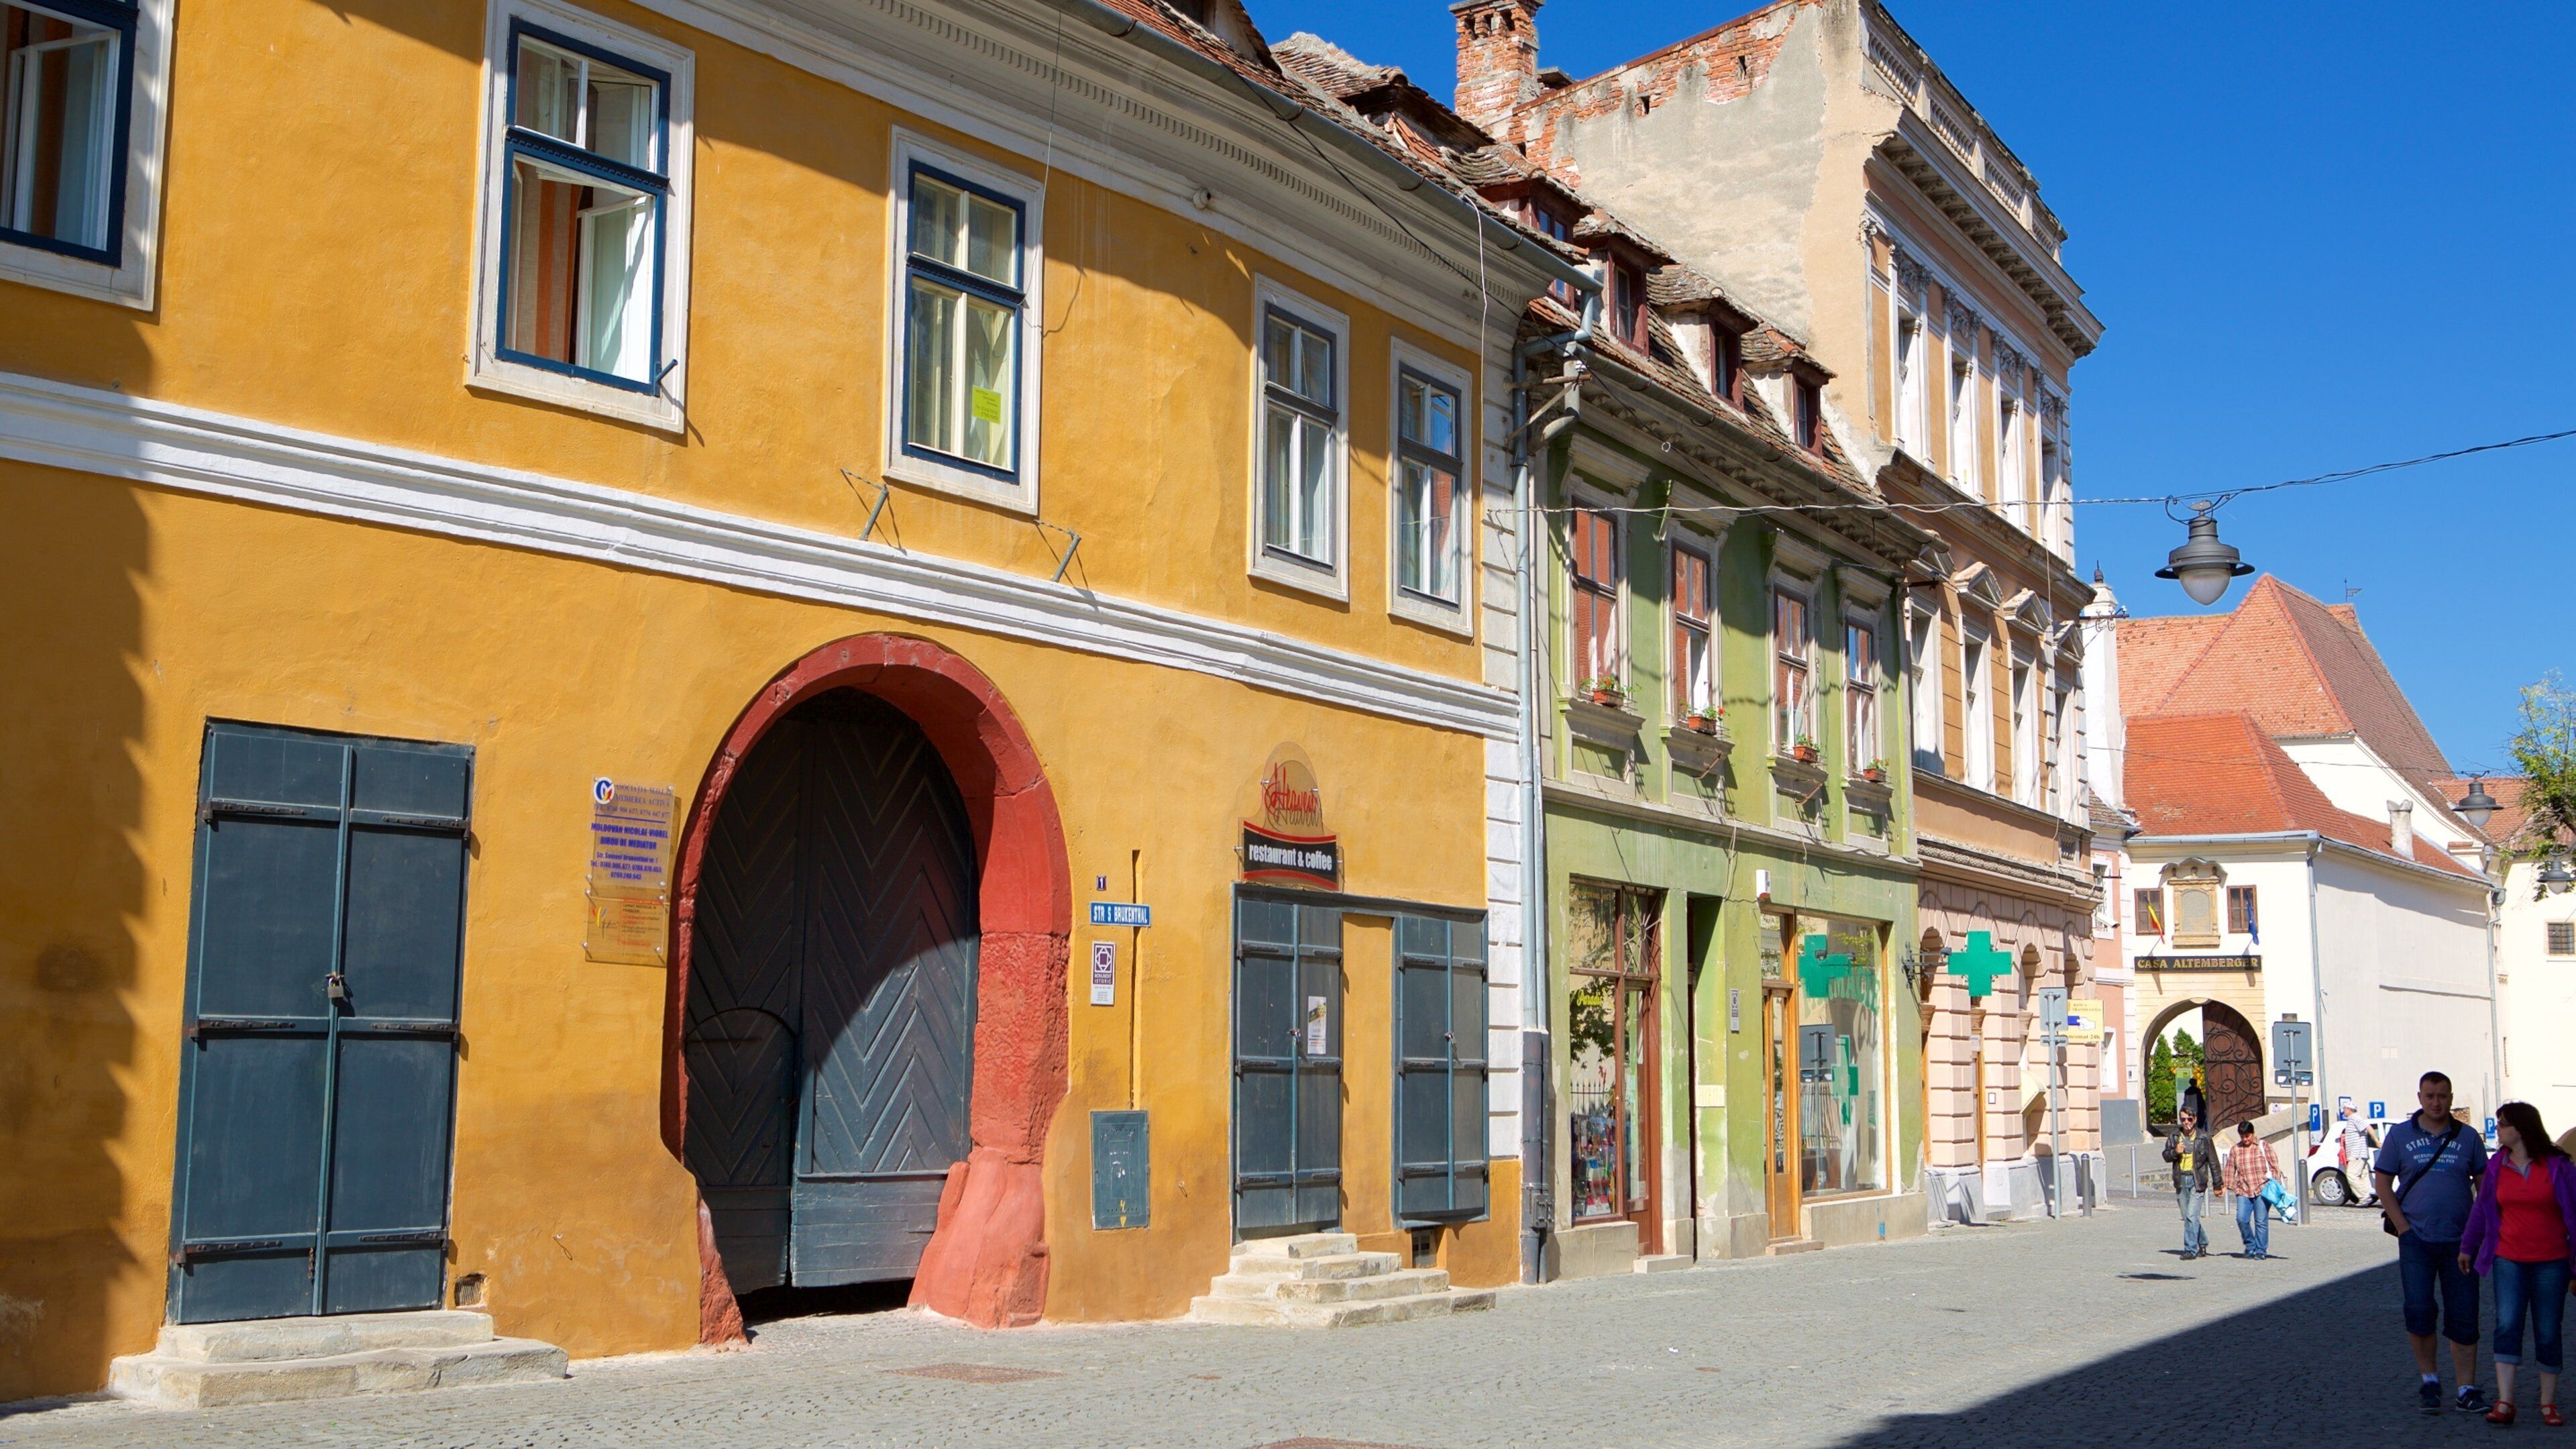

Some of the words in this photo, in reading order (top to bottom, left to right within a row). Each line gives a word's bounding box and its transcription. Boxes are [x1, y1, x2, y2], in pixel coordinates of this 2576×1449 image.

[591, 822, 623, 833] MOLDOVAN
[624, 826, 647, 837] NICOLAE
[649, 829, 667, 839] VIOREL
[600, 836, 619, 845] BIROU
[620, 838, 627, 847] DE
[628, 839, 657, 849] MEDIATOR
[1249, 844, 1296, 866] restaurant
[1297, 851, 1304, 867] &
[1305, 851, 1332, 871] coffee
[1100, 877, 1104, 889] 1
[1093, 905, 1106, 922] STR.
[1108, 906, 1112, 922] S.
[1114, 906, 1147, 924] BRUKENTHAL
[2137, 959, 2168, 969] CASA
[2173, 958, 2258, 968] ALTEMBERGER
[2312, 1108, 2318, 1122] P
[2374, 1104, 2381, 1118] P
[2487, 1120, 2493, 1132] P
[2406, 1137, 2430, 1152] STATE
